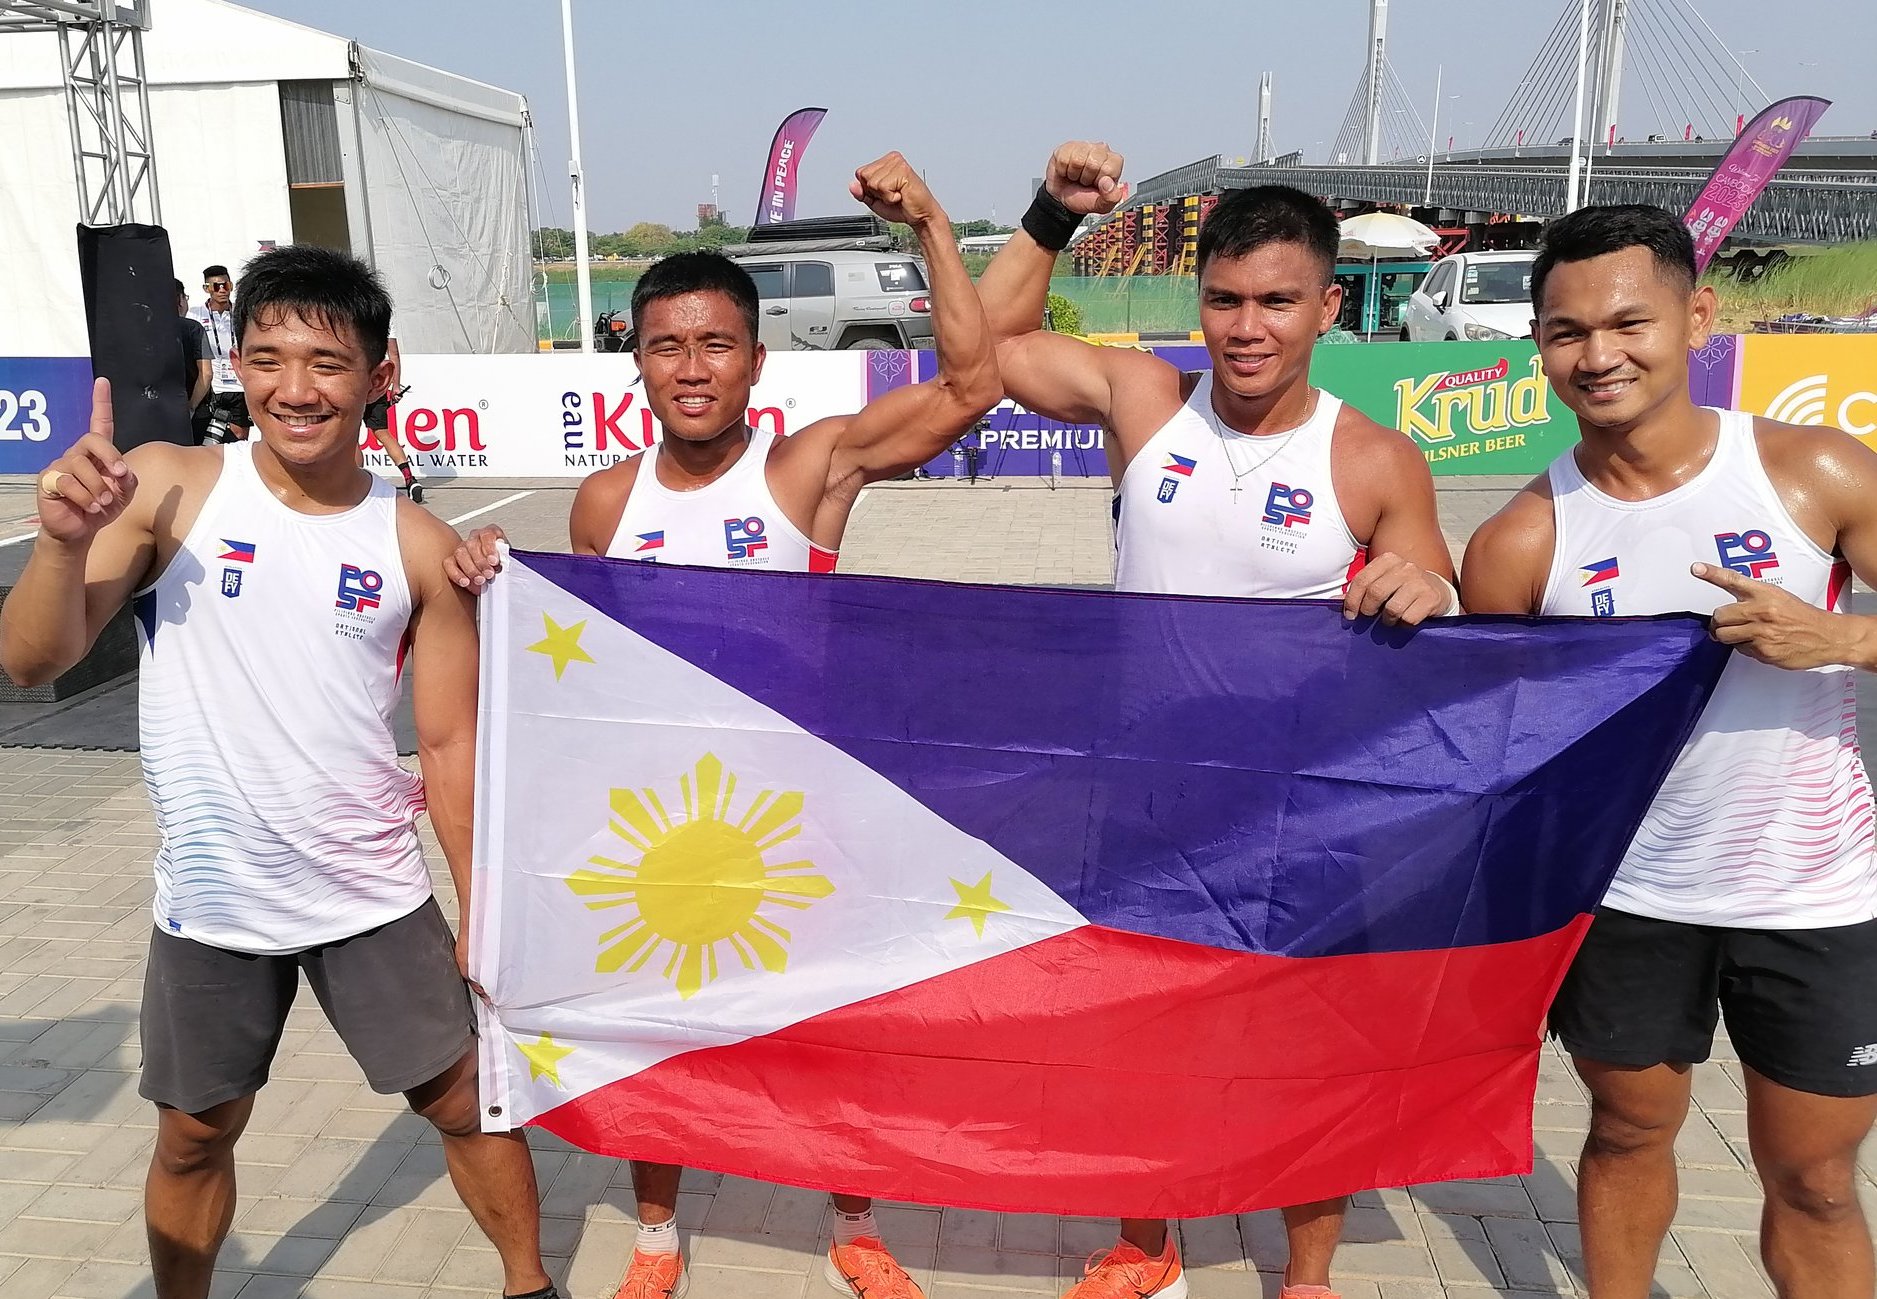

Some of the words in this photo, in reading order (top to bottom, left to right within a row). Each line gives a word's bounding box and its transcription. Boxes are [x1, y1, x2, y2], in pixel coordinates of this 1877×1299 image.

[775, 139, 795, 188] PEACE
[772, 190, 785, 208] IN
[1703, 182, 1749, 212] 2023
[1444, 367, 1503, 388] QUALITY
[1393, 354, 1552, 444] Krud
[0, 389, 52, 442] 23
[561, 391, 584, 451] eau
[430, 454, 489, 467] WATER
[564, 454, 632, 467] NATUR
[1423, 441, 1481, 463] ILSNER
[1485, 433, 1526, 453] BEER
